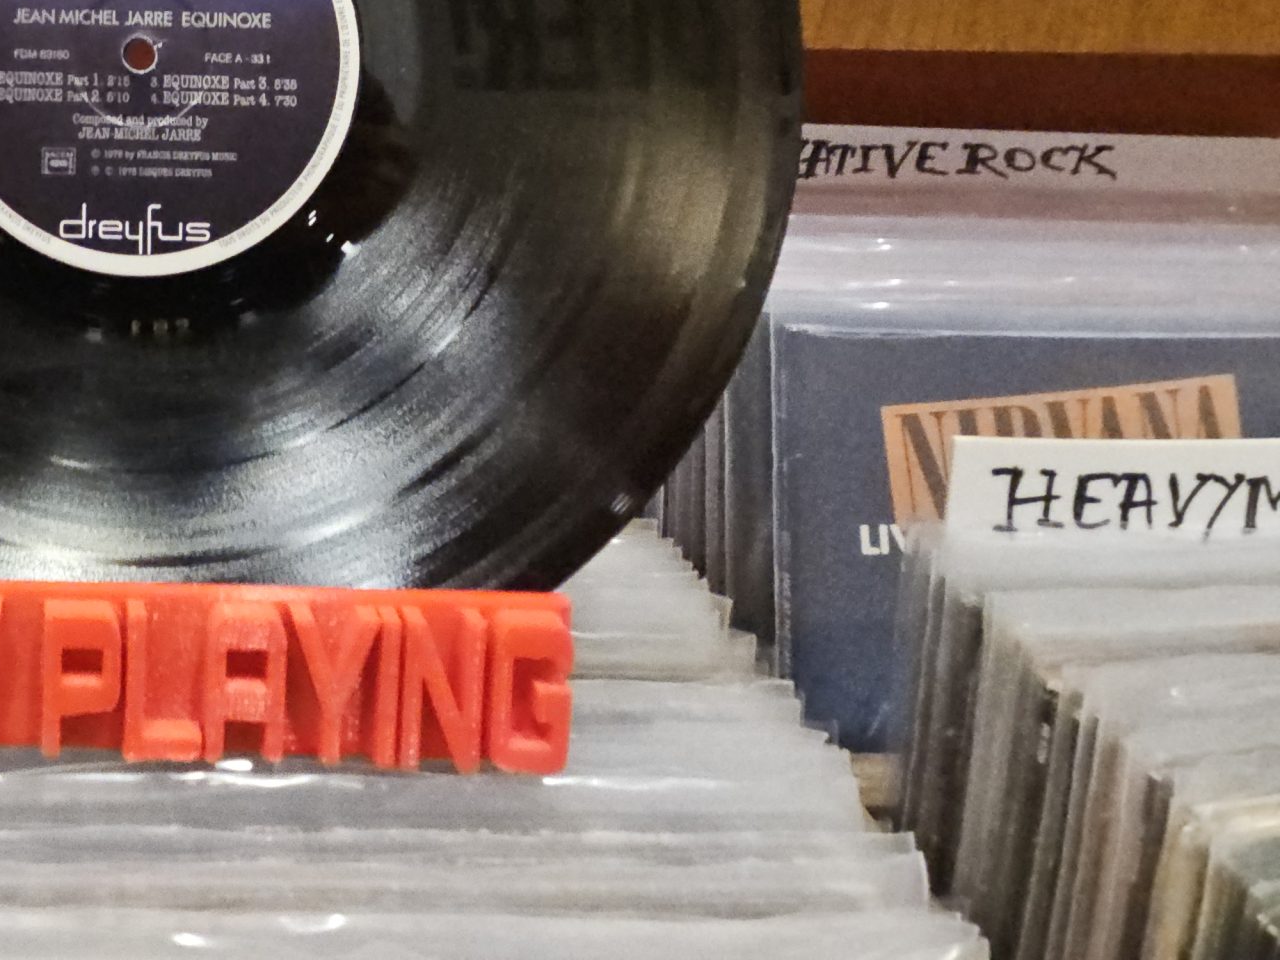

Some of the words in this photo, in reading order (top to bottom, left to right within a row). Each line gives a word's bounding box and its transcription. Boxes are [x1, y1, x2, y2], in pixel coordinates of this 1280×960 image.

[13, 7, 56, 25] JEAN
[58, 9, 119, 26] MICHEL
[125, 10, 173, 27] JARRE
[181, 12, 272, 29] EQUINOXE
[204, 52, 233, 64] FACE
[234, 53, 243, 64] A
[250, 54, 264, 64] 33
[67, 74, 89, 86] Part
[163, 74, 230, 90] EQUINOXE
[233, 77, 256, 90] Part
[67, 90, 89, 103] Part
[163, 91, 230, 107] EQUINOXE
[233, 94, 256, 106] Part
[72, 113, 123, 127] Composed
[126, 113, 145, 126] and
[147, 115, 193, 128] produced
[195, 115, 209, 130] by
[78, 126, 110, 140] JEAN
[113, 127, 159, 141] MICHEL
[161, 128, 202, 142] JARRE
[172, 150, 211, 161] DREYFUS
[956, 142, 1117, 180] ROCK
[174, 167, 213, 178] DREYFUS
[59, 202, 211, 256] dreyfus
[859, 524, 907, 556] LIV
[41, 596, 575, 776] PLAYING
